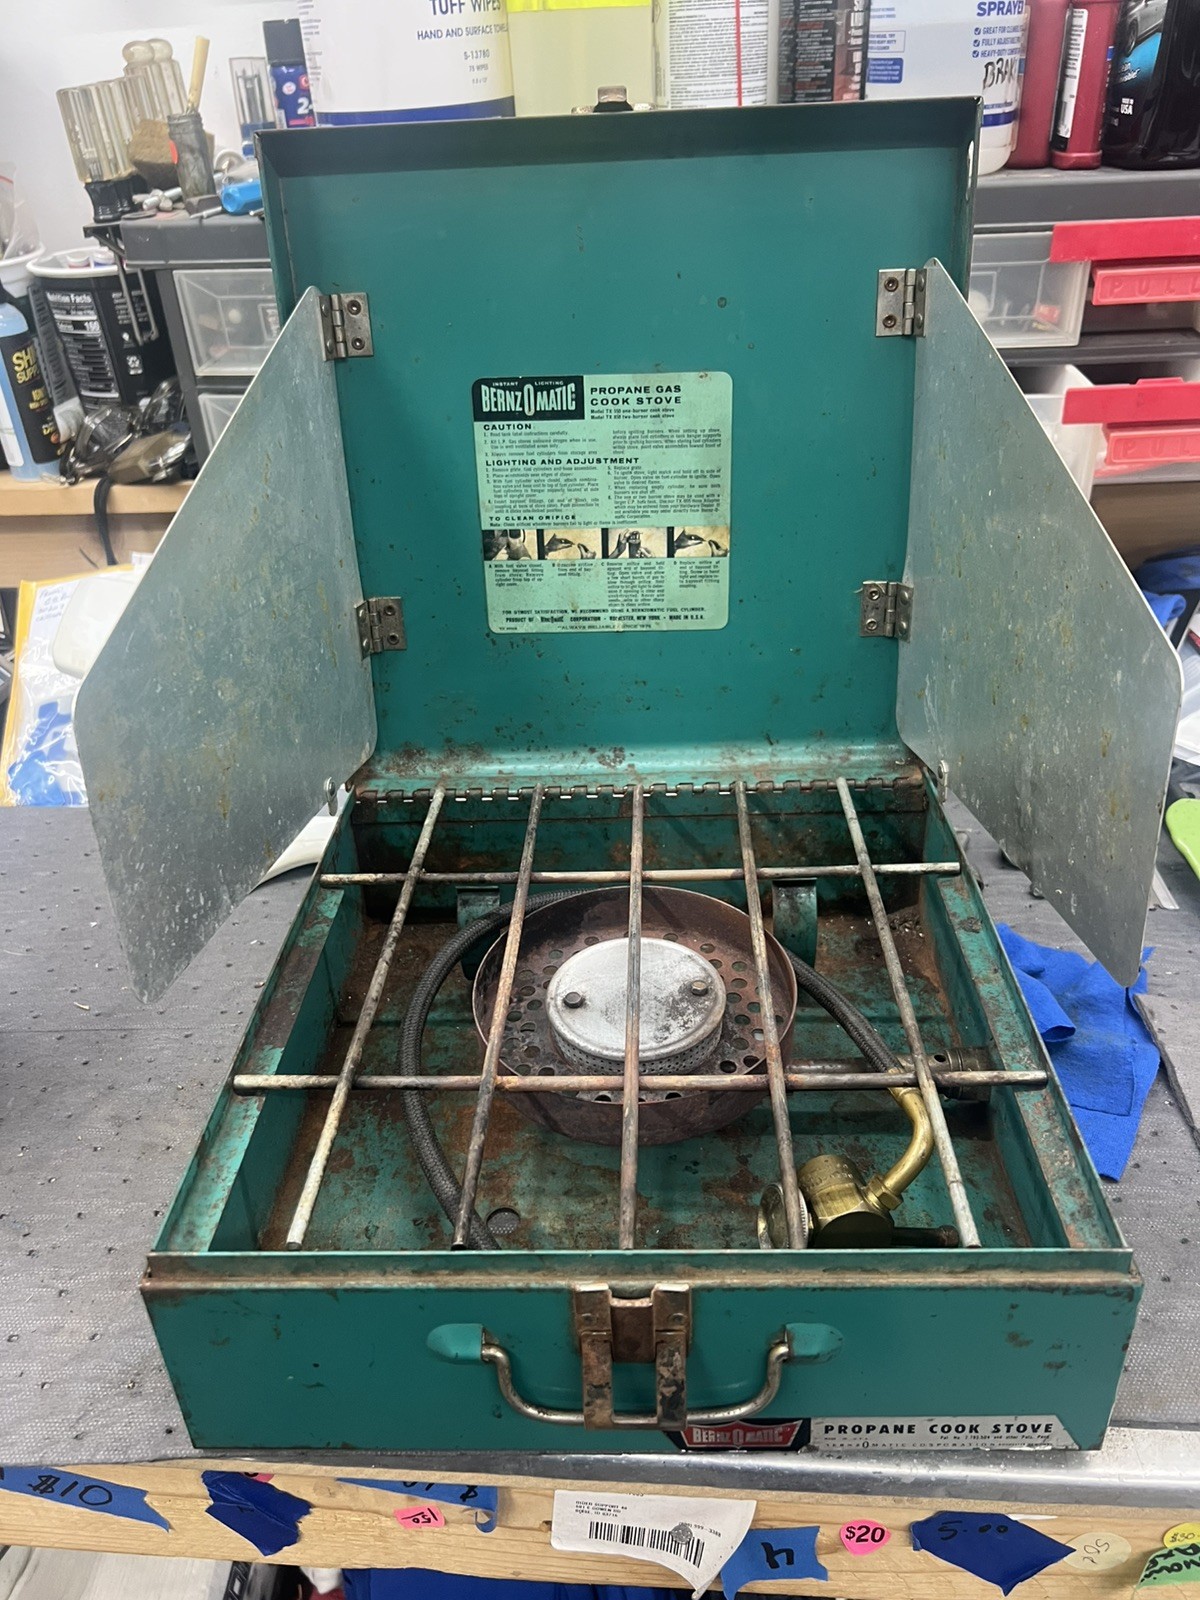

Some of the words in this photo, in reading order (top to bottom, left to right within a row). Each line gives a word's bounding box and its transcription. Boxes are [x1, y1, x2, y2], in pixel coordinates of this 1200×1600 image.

[429, 0, 465, 15] TUFF
[471, 0, 500, 12] WIPES
[417, 30, 443, 40] HAND
[446, 28, 463, 38] AND
[466, 25, 493, 36] SURFACE
[1121, 104, 1132, 115] USA
[591, 386, 650, 395] PROPANE
[656, 385, 681, 394] GAS
[591, 397, 630, 406] COOK
[636, 396, 681, 405] STOVE
[824, 1424, 916, 1434] PROPANE
[929, 1424, 980, 1434] COOK
[992, 1423, 1053, 1433] STOVE
[27, 1475, 112, 1506] $10
[844, 1524, 886, 1544] $20
